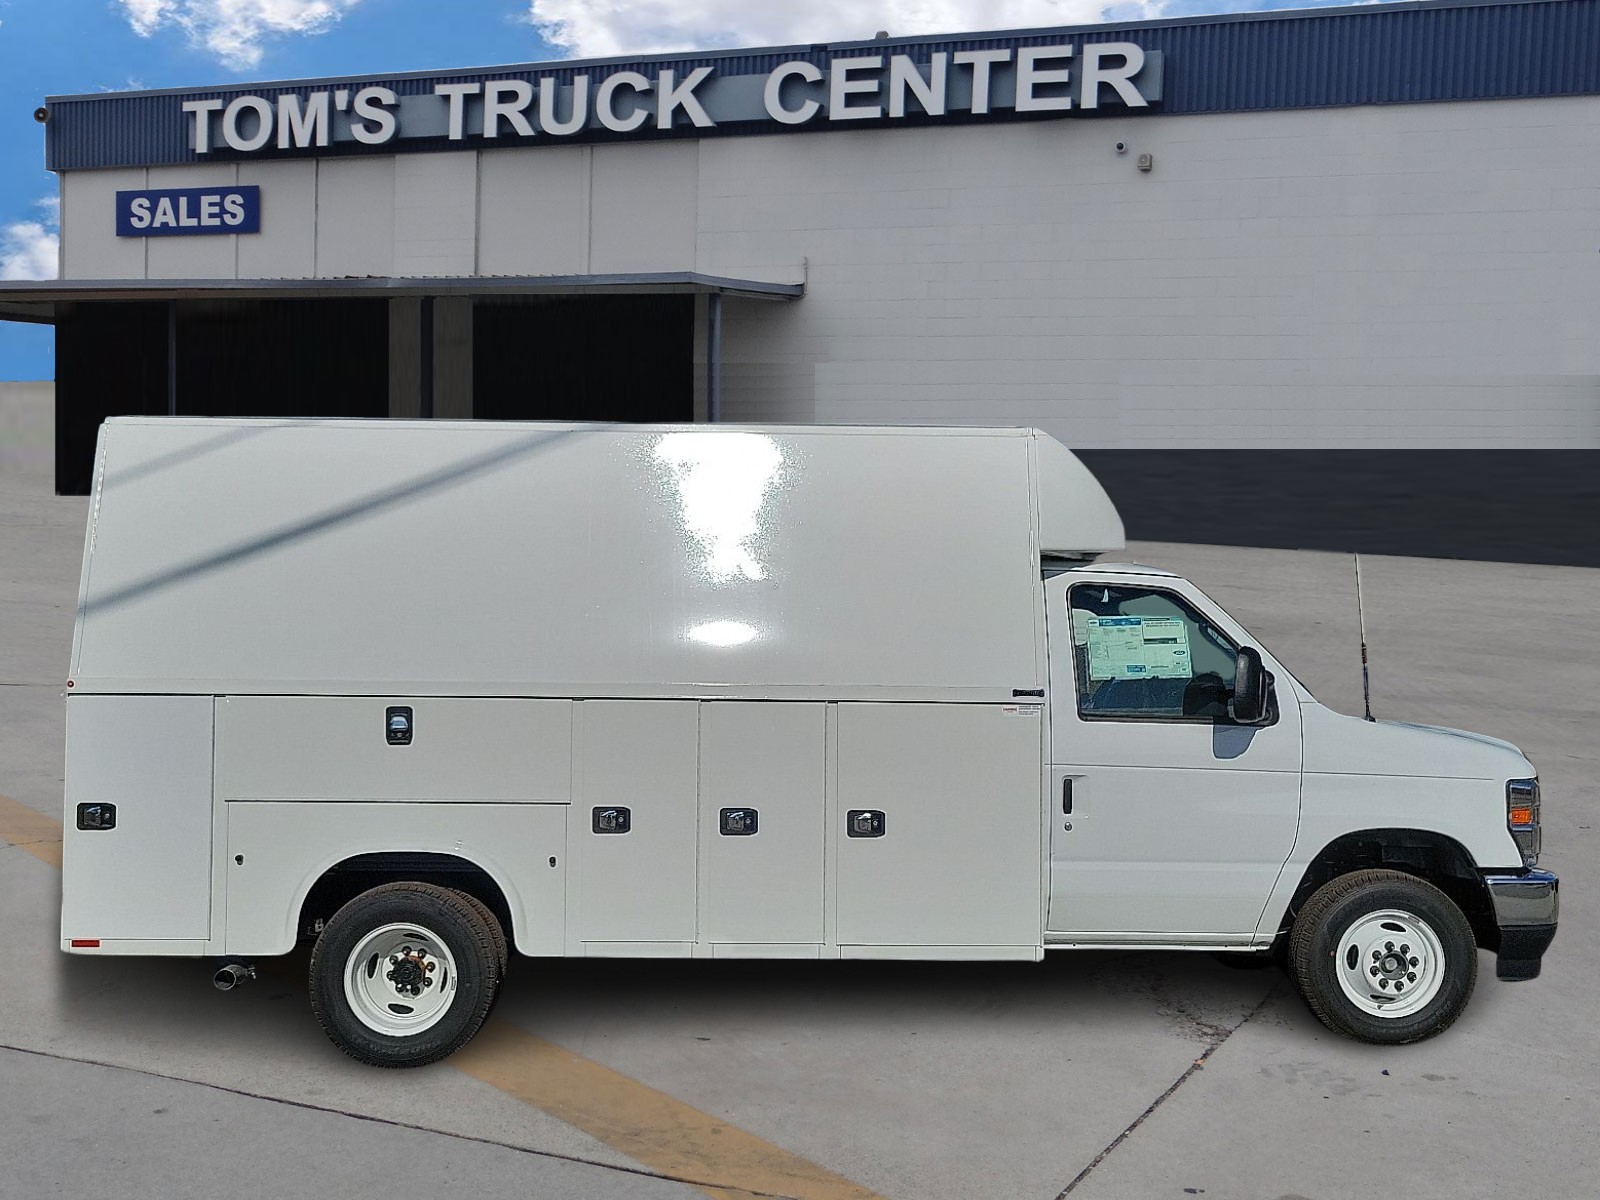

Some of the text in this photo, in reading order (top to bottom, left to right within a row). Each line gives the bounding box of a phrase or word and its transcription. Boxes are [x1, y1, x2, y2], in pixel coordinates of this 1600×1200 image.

[182, 41, 1149, 153] TOM'S TRUCK CENTER
[129, 193, 246, 229] SALES
